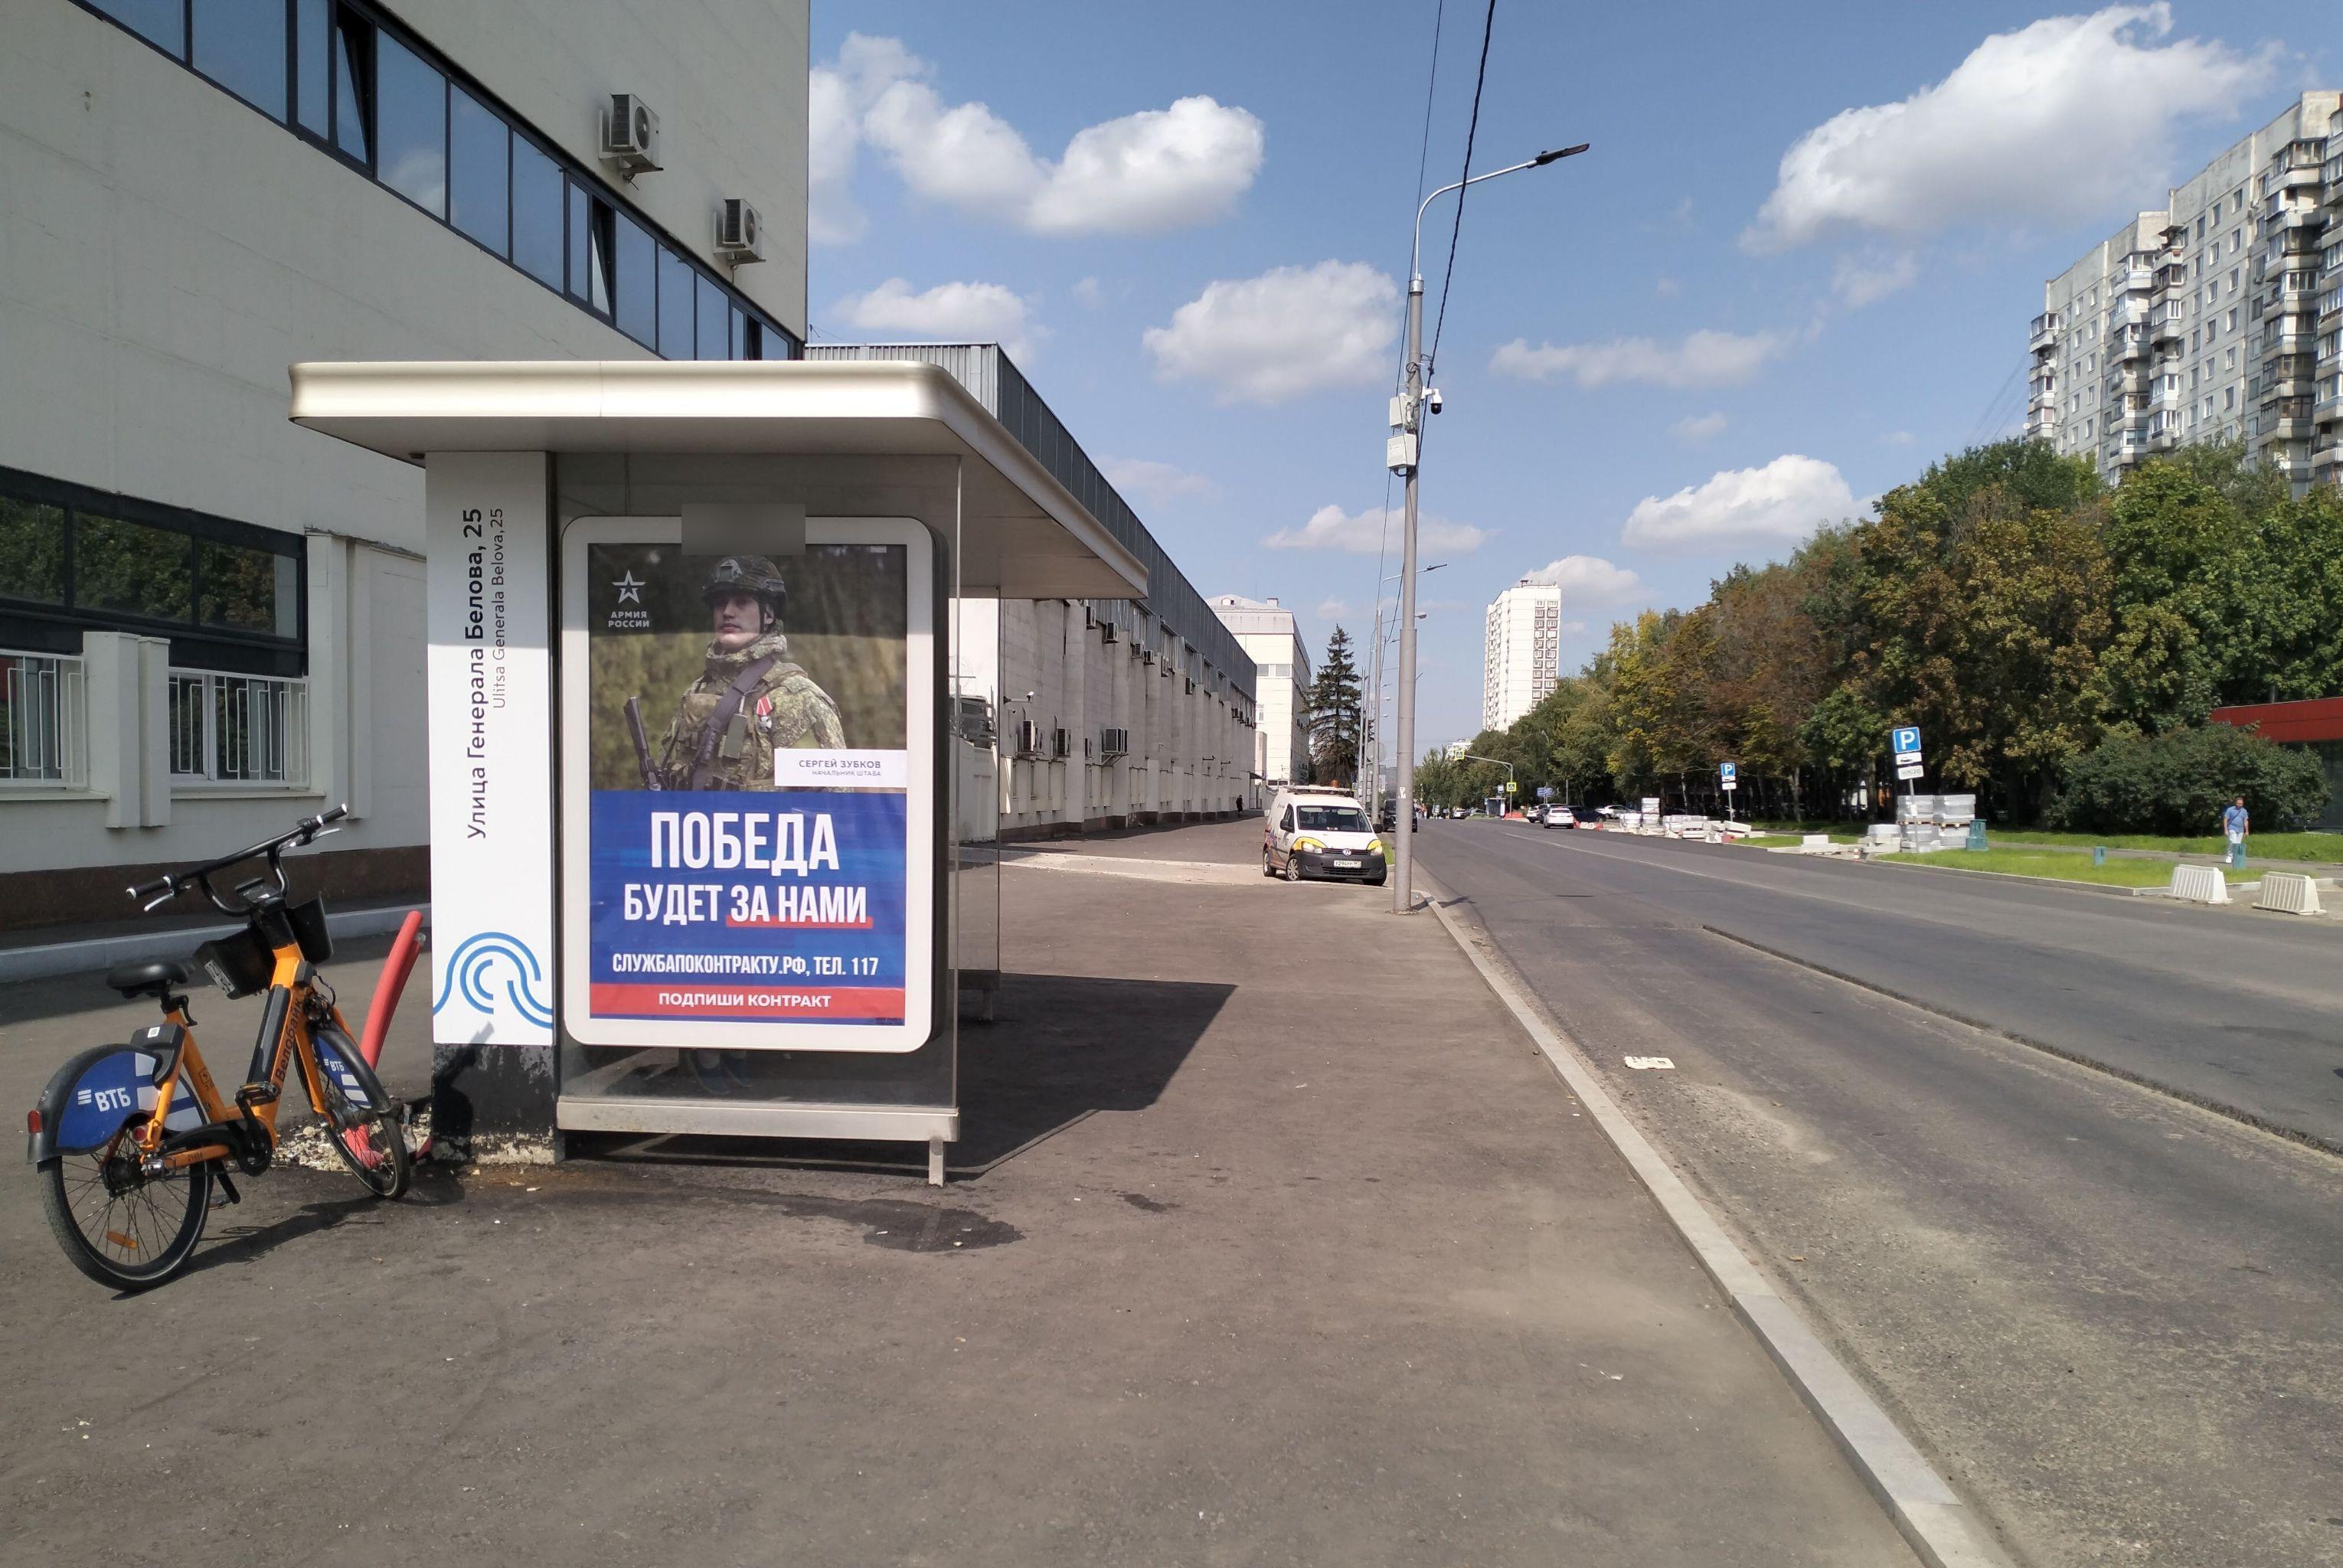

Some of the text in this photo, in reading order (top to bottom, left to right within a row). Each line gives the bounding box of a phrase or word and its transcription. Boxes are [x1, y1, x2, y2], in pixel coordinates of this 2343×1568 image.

[492, 590, 505, 660] Generala
[463, 508, 489, 839] Улица Генерала Белова, 25
[492, 666, 505, 709] Ulitsa
[1900, 730, 1915, 750] P
[799, 759, 881, 769] СЕРГЕЙ ЗУБКОВ
[1724, 764, 1733, 775] P
[651, 812, 839, 877] ПОБЕДА
[624, 884, 866, 926] БУДЕТ ЗА НАМИ
[613, 953, 878, 977] СЛУЖБАПОКОНТРАКТУ.РФ, ТЕЛ. 117
[658, 992, 832, 1008] ПОДПИШИ КОНТРАКТ
[276, 998, 304, 1082] Велобайк
[329, 1060, 345, 1072] ВТБ
[94, 1087, 131, 1112] ВТБ
